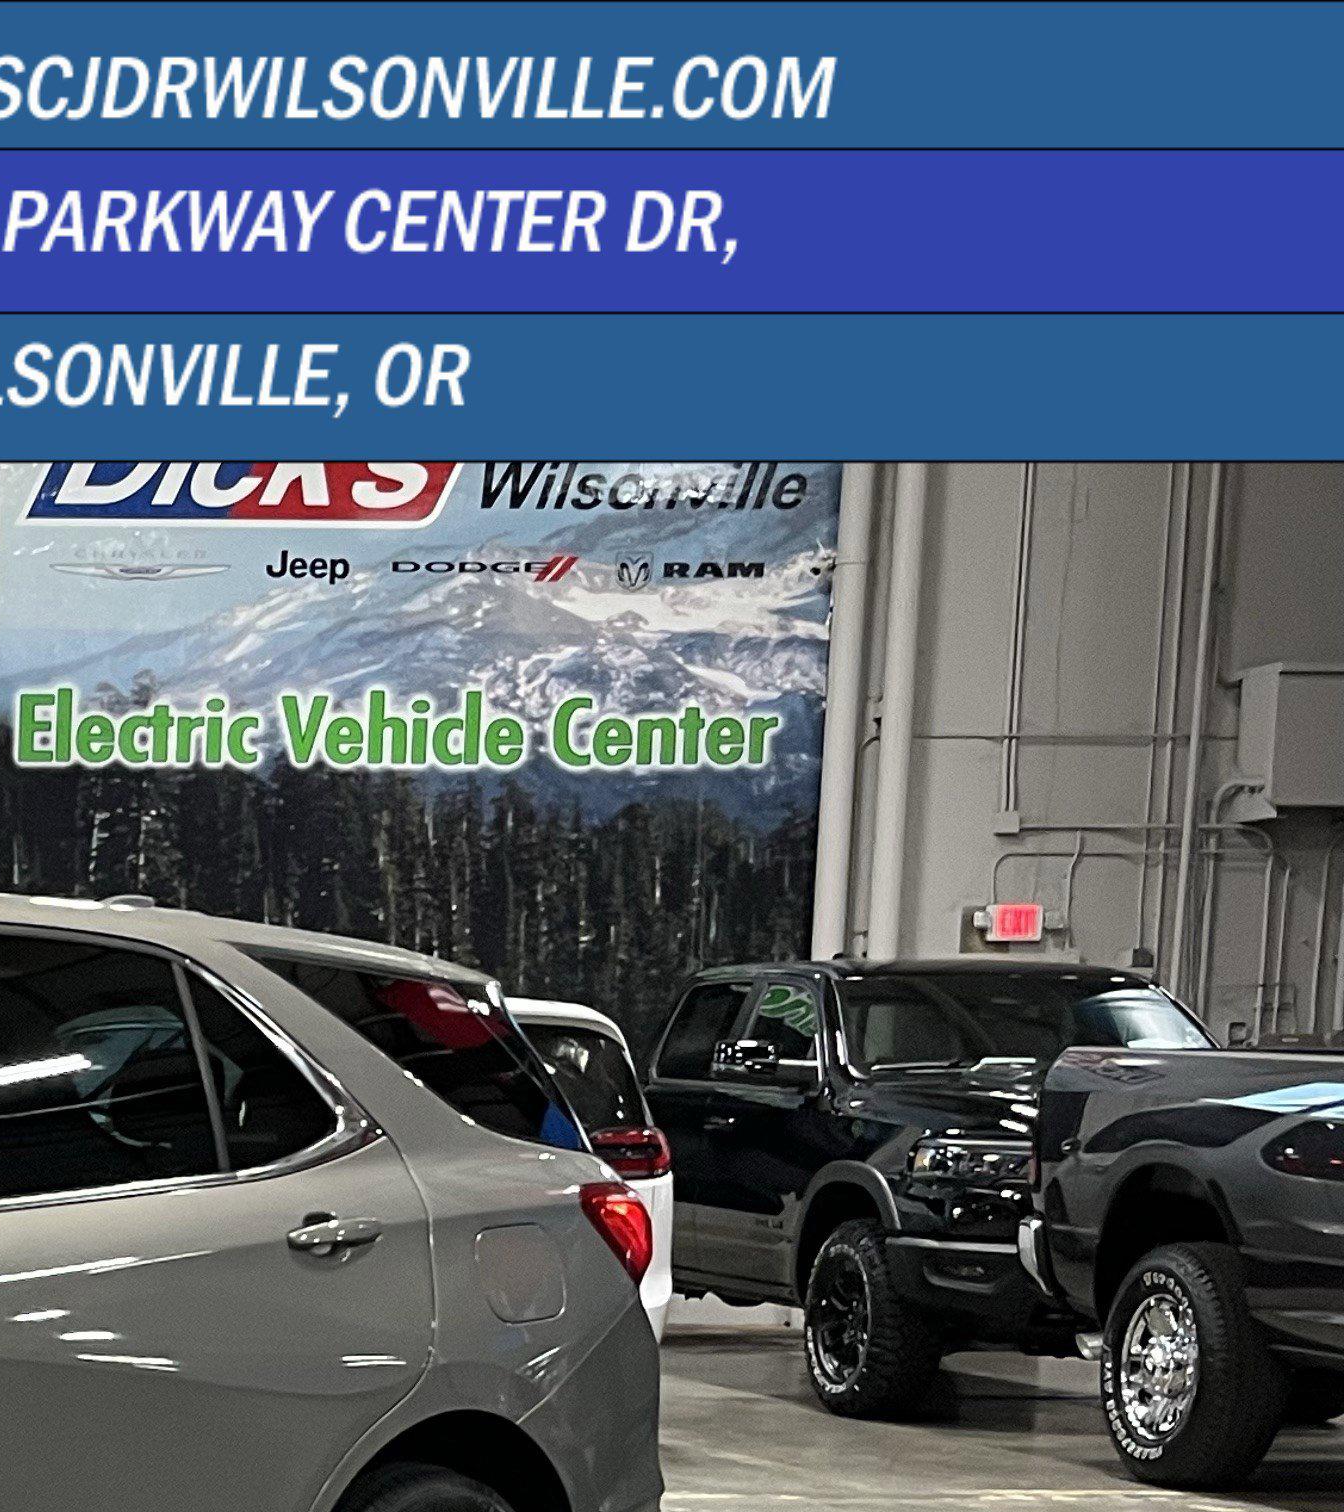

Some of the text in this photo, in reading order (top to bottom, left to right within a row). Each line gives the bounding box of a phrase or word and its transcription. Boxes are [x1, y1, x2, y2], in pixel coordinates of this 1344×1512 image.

[266, 550, 350, 585] Jeep
[392, 561, 548, 573] DODGE
[663, 562, 766, 579] RAM
[20, 688, 779, 766] Electric Vehicle Center
